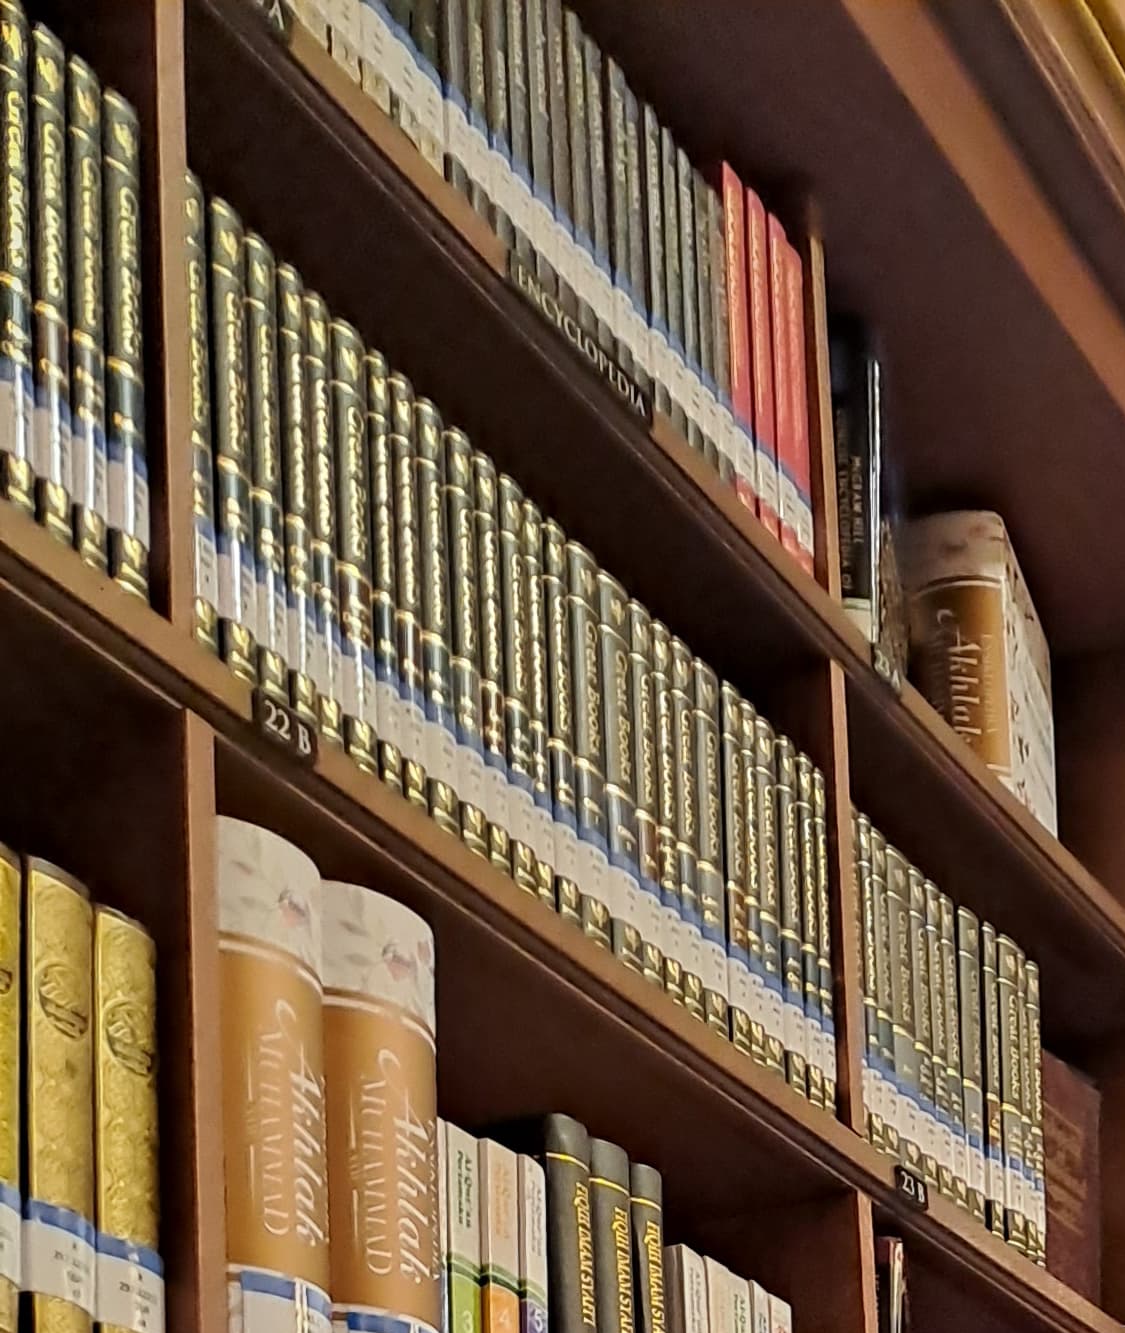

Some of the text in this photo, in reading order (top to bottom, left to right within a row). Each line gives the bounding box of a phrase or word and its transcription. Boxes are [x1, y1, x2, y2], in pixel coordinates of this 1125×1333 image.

[518, 264, 646, 416] ENCYCLOPEDIA
[265, 700, 311, 754] 22 B
[900, 1170, 926, 1204] 23 B
